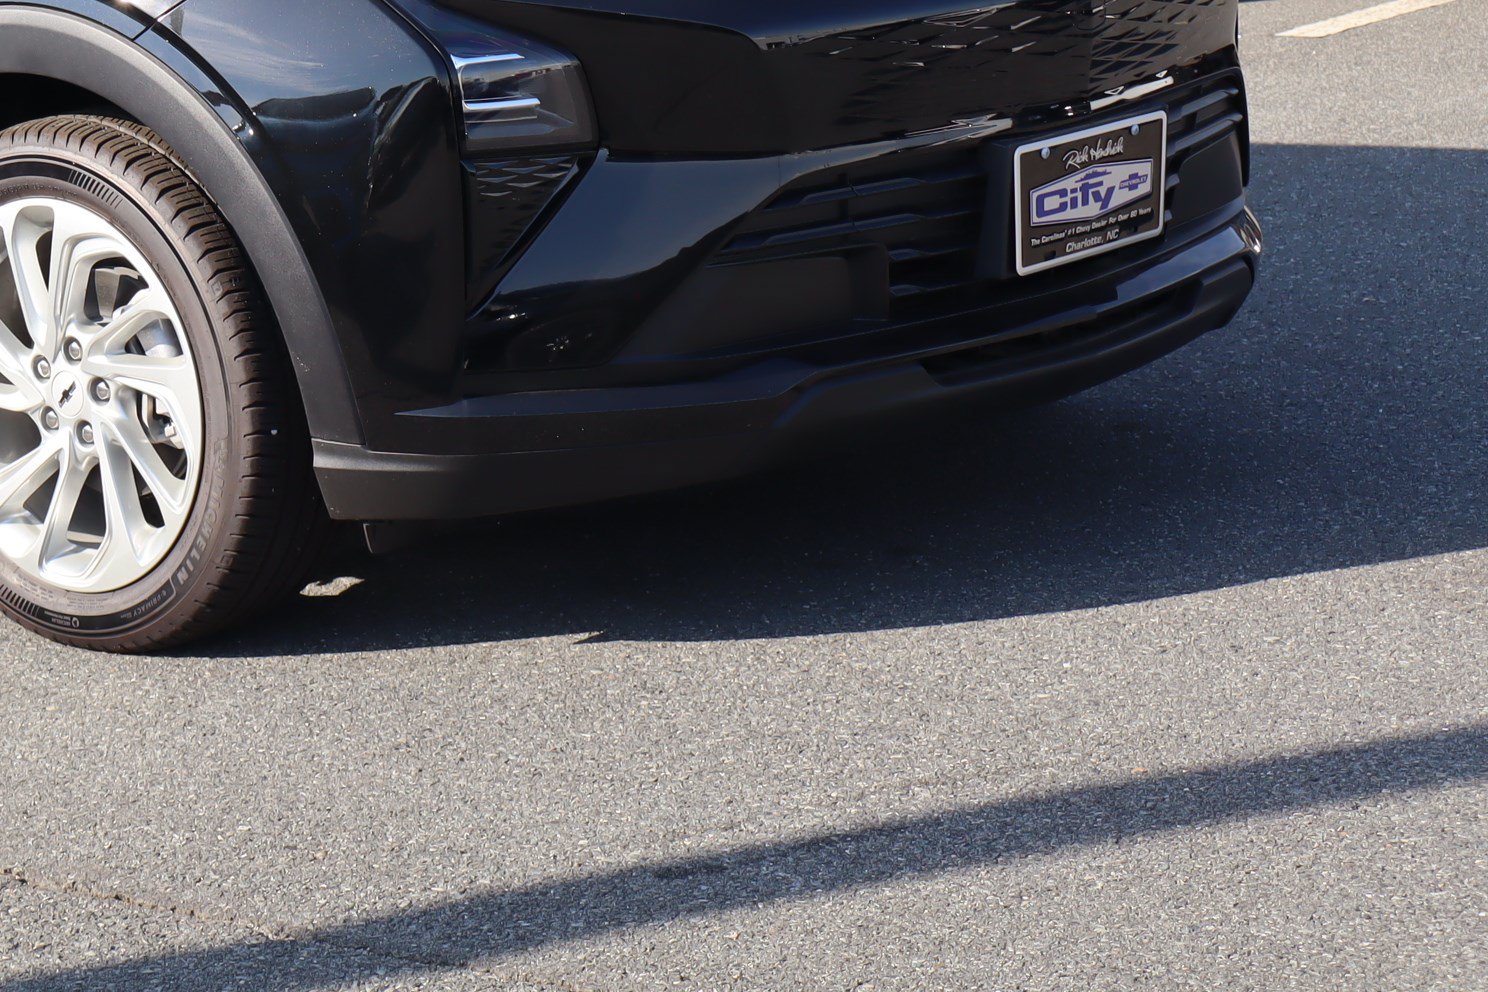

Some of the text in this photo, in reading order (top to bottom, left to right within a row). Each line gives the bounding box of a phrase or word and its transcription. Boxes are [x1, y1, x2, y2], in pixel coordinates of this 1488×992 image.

[1035, 181, 1116, 219] City
[1031, 238, 1041, 246] The
[1117, 212, 1130, 222] Over
[1065, 228, 1120, 253] Charlotte, NC
[176, 474, 225, 586] MICHELIN
